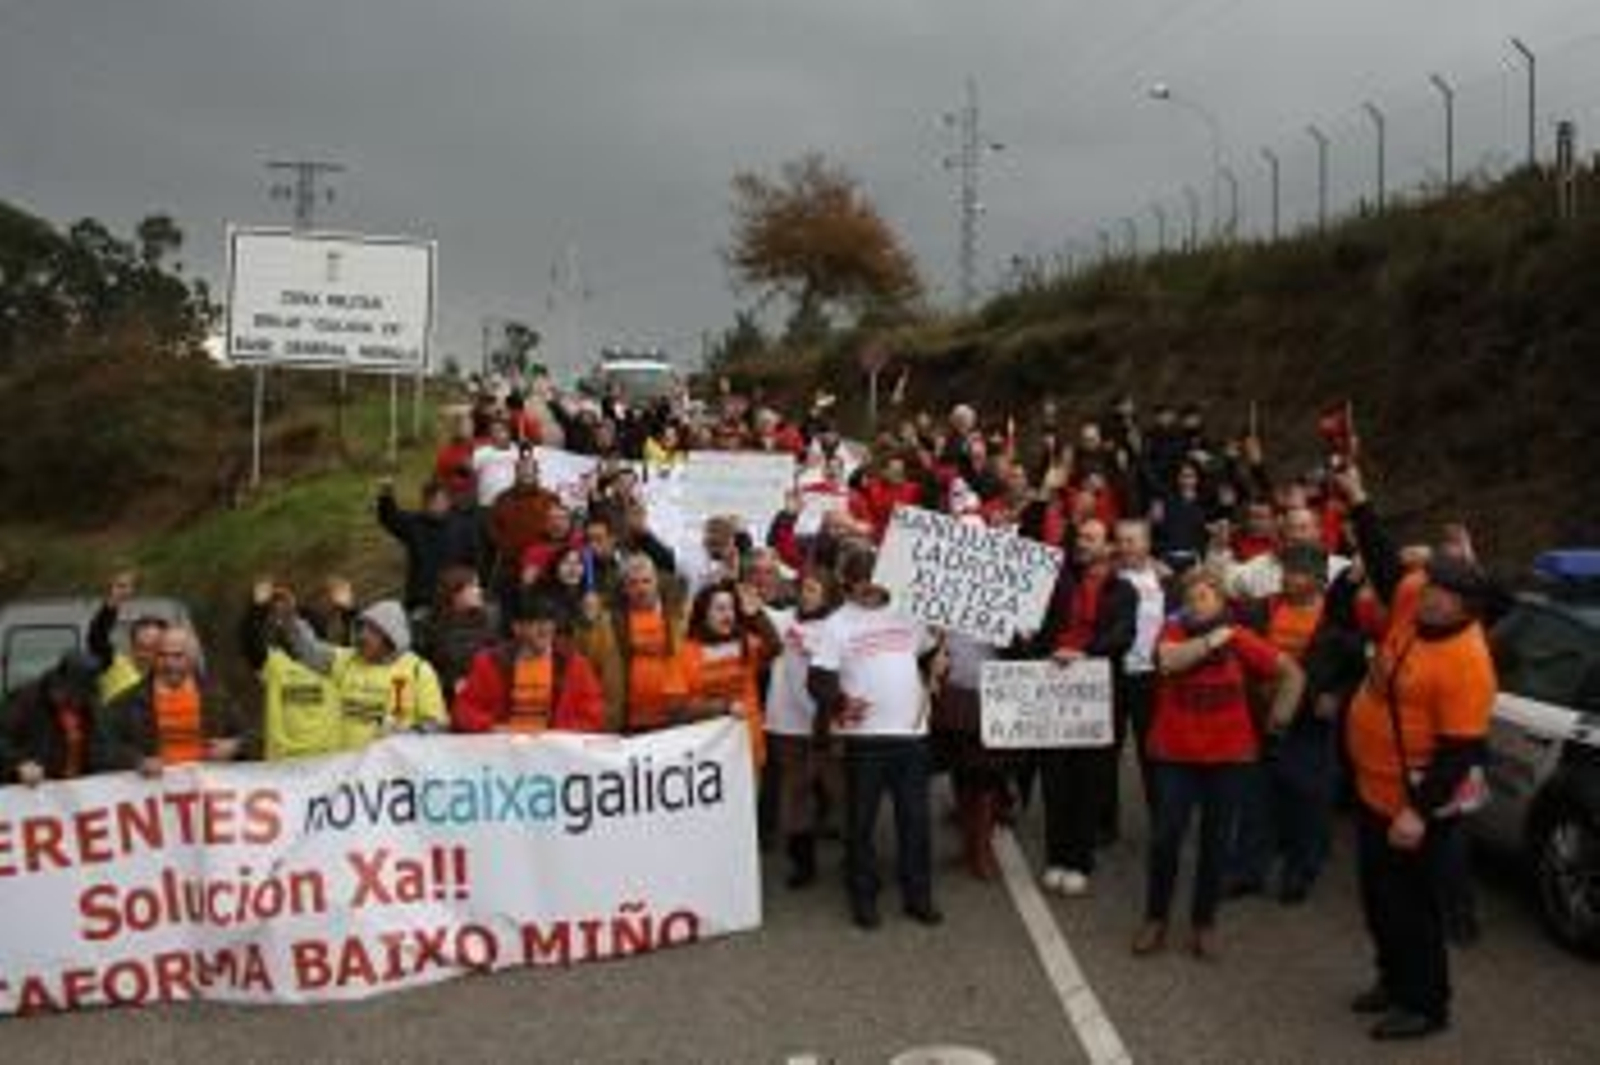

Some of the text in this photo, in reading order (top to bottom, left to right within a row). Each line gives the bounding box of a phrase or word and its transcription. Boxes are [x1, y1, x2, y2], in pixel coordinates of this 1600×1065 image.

[304, 753, 724, 835] novacaixagalicia
[78, 846, 469, 941] Solución Xa!!
[0, 944, 273, 1018] AFORMA
[291, 925, 499, 992] BAIXO
